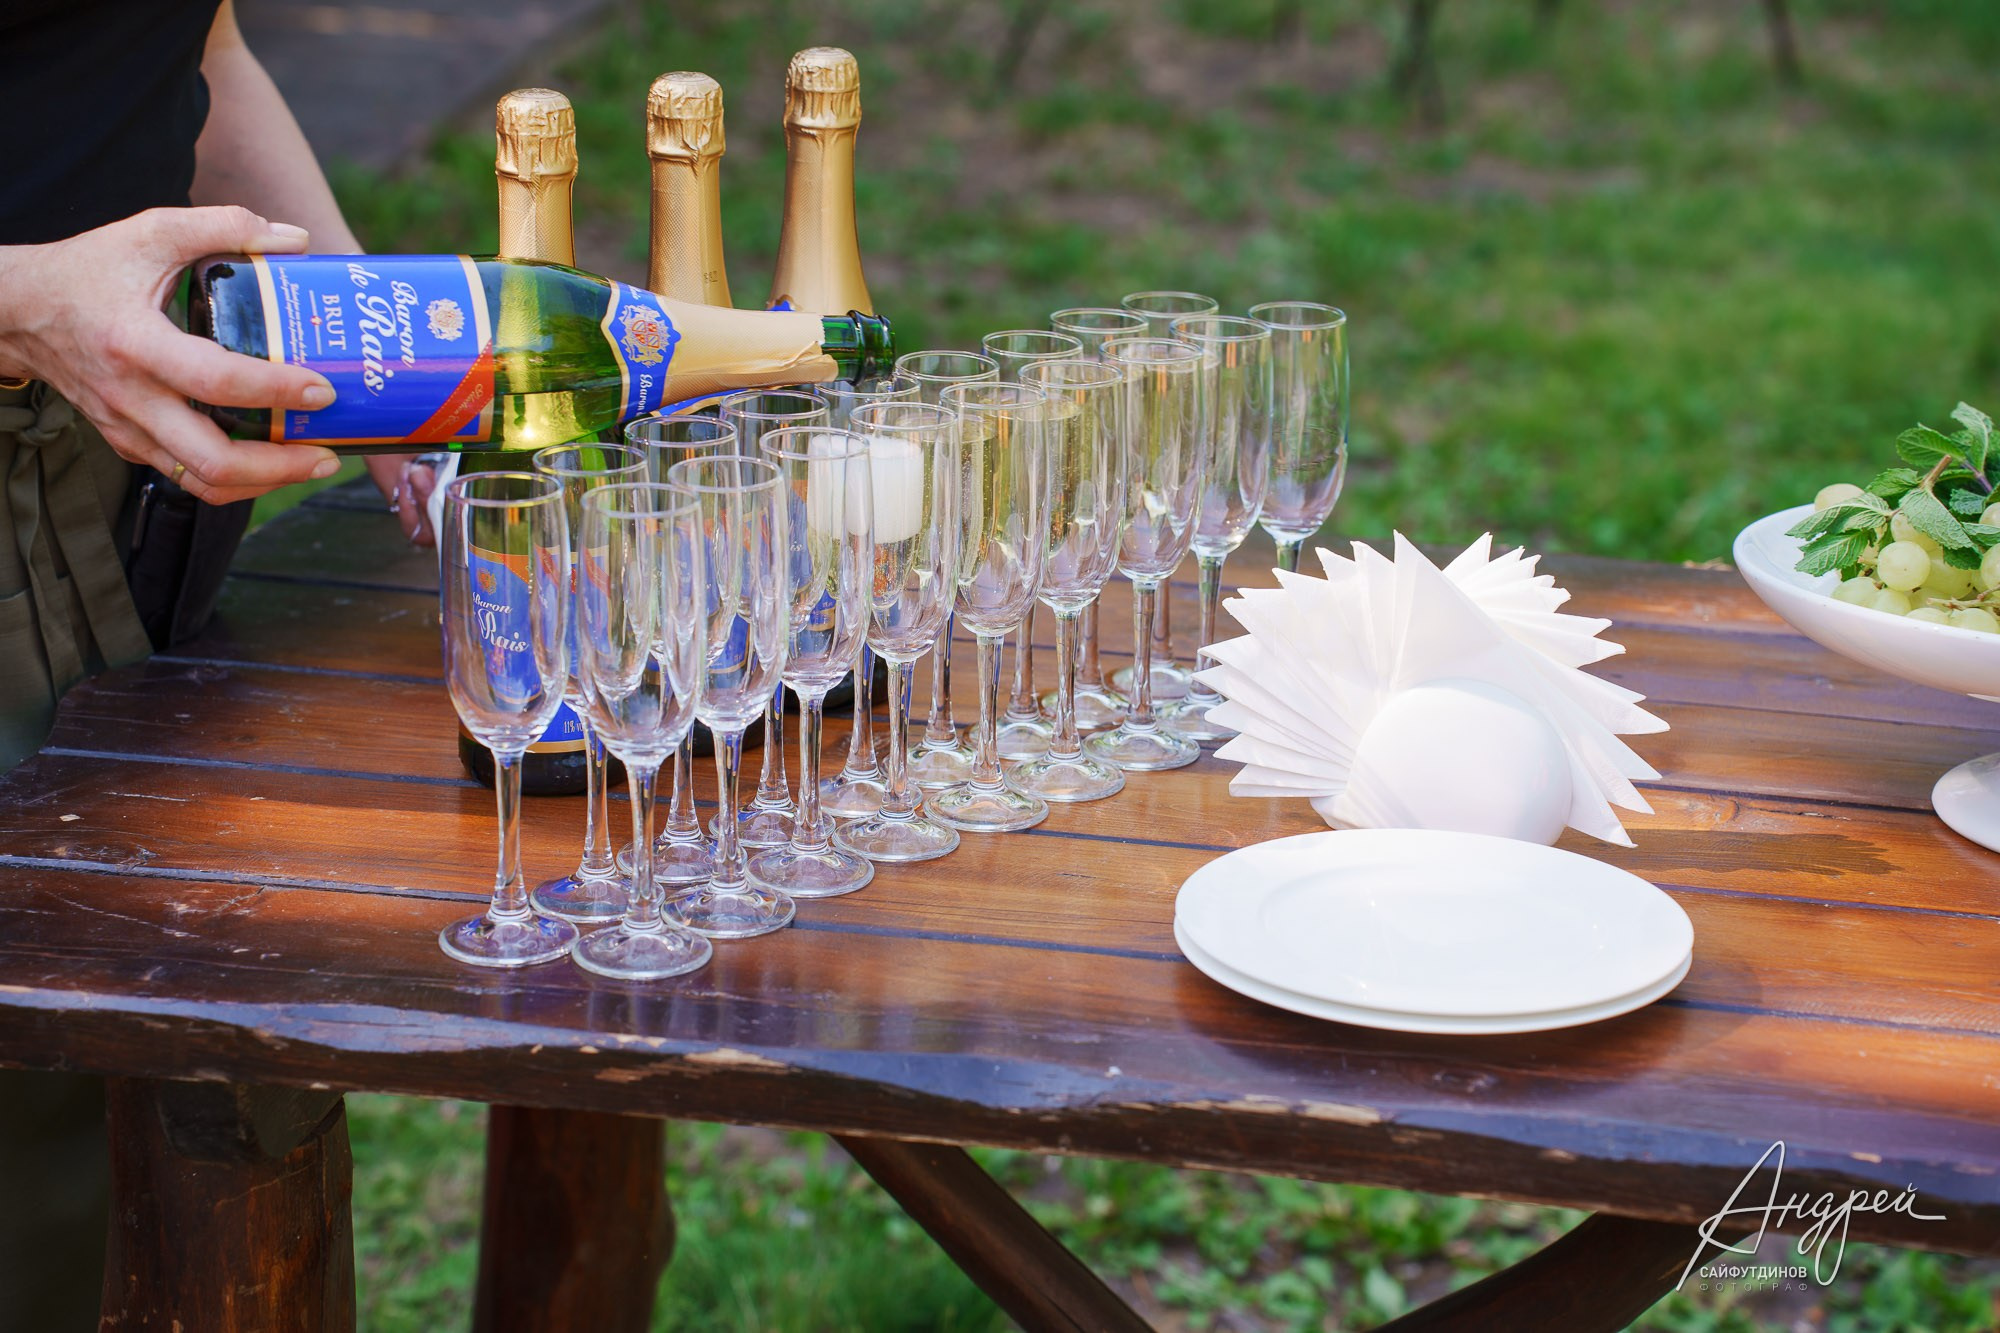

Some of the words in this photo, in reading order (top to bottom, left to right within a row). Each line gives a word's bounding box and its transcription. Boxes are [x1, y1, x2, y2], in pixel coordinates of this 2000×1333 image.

[346, 263, 380, 290] de
[321, 293, 348, 351] BRUT
[354, 291, 400, 397] Rais
[390, 280, 420, 369] Baron
[637, 373, 653, 411] Baron
[478, 608, 530, 653] Rais
